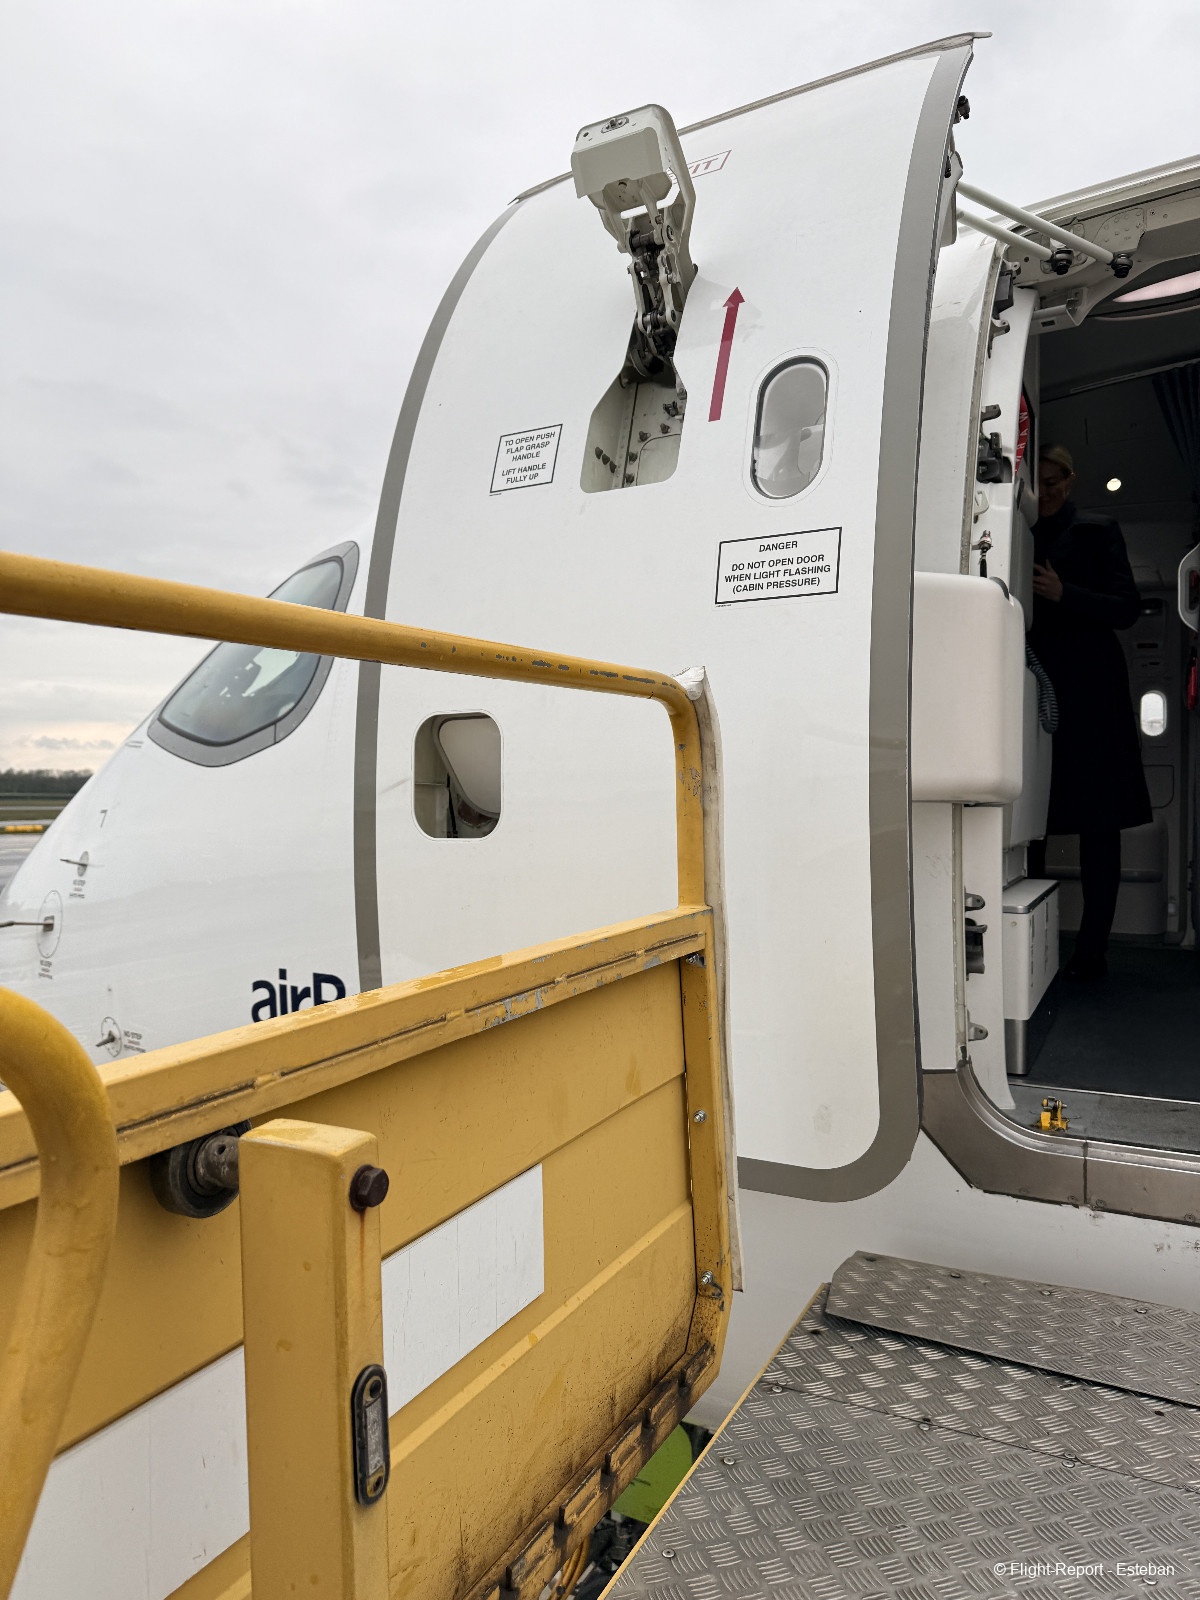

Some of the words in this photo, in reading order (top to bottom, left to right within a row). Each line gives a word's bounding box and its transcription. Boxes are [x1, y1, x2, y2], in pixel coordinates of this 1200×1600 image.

[515, 436, 534, 444] OPEN
[536, 432, 555, 440] PUSH
[506, 445, 524, 454] FLAP
[525, 441, 550, 451] GRASP
[512, 451, 541, 462] HANDLE
[502, 468, 516, 476] LIFT
[518, 463, 546, 473] HANDLE
[506, 475, 528, 484] FULLY
[529, 472, 539, 481] UP
[759, 540, 798, 553] DANGER
[731, 563, 745, 572] DO
[747, 560, 767, 570] NOT
[768, 557, 794, 568] OPEN
[796, 554, 825, 565] DOOR
[724, 573, 752, 583] WHEN
[754, 570, 781, 580] LIGHT
[783, 565, 831, 577] FLASHING
[732, 582, 764, 594] (CABIN
[766, 577, 821, 590] PRESSURE)
